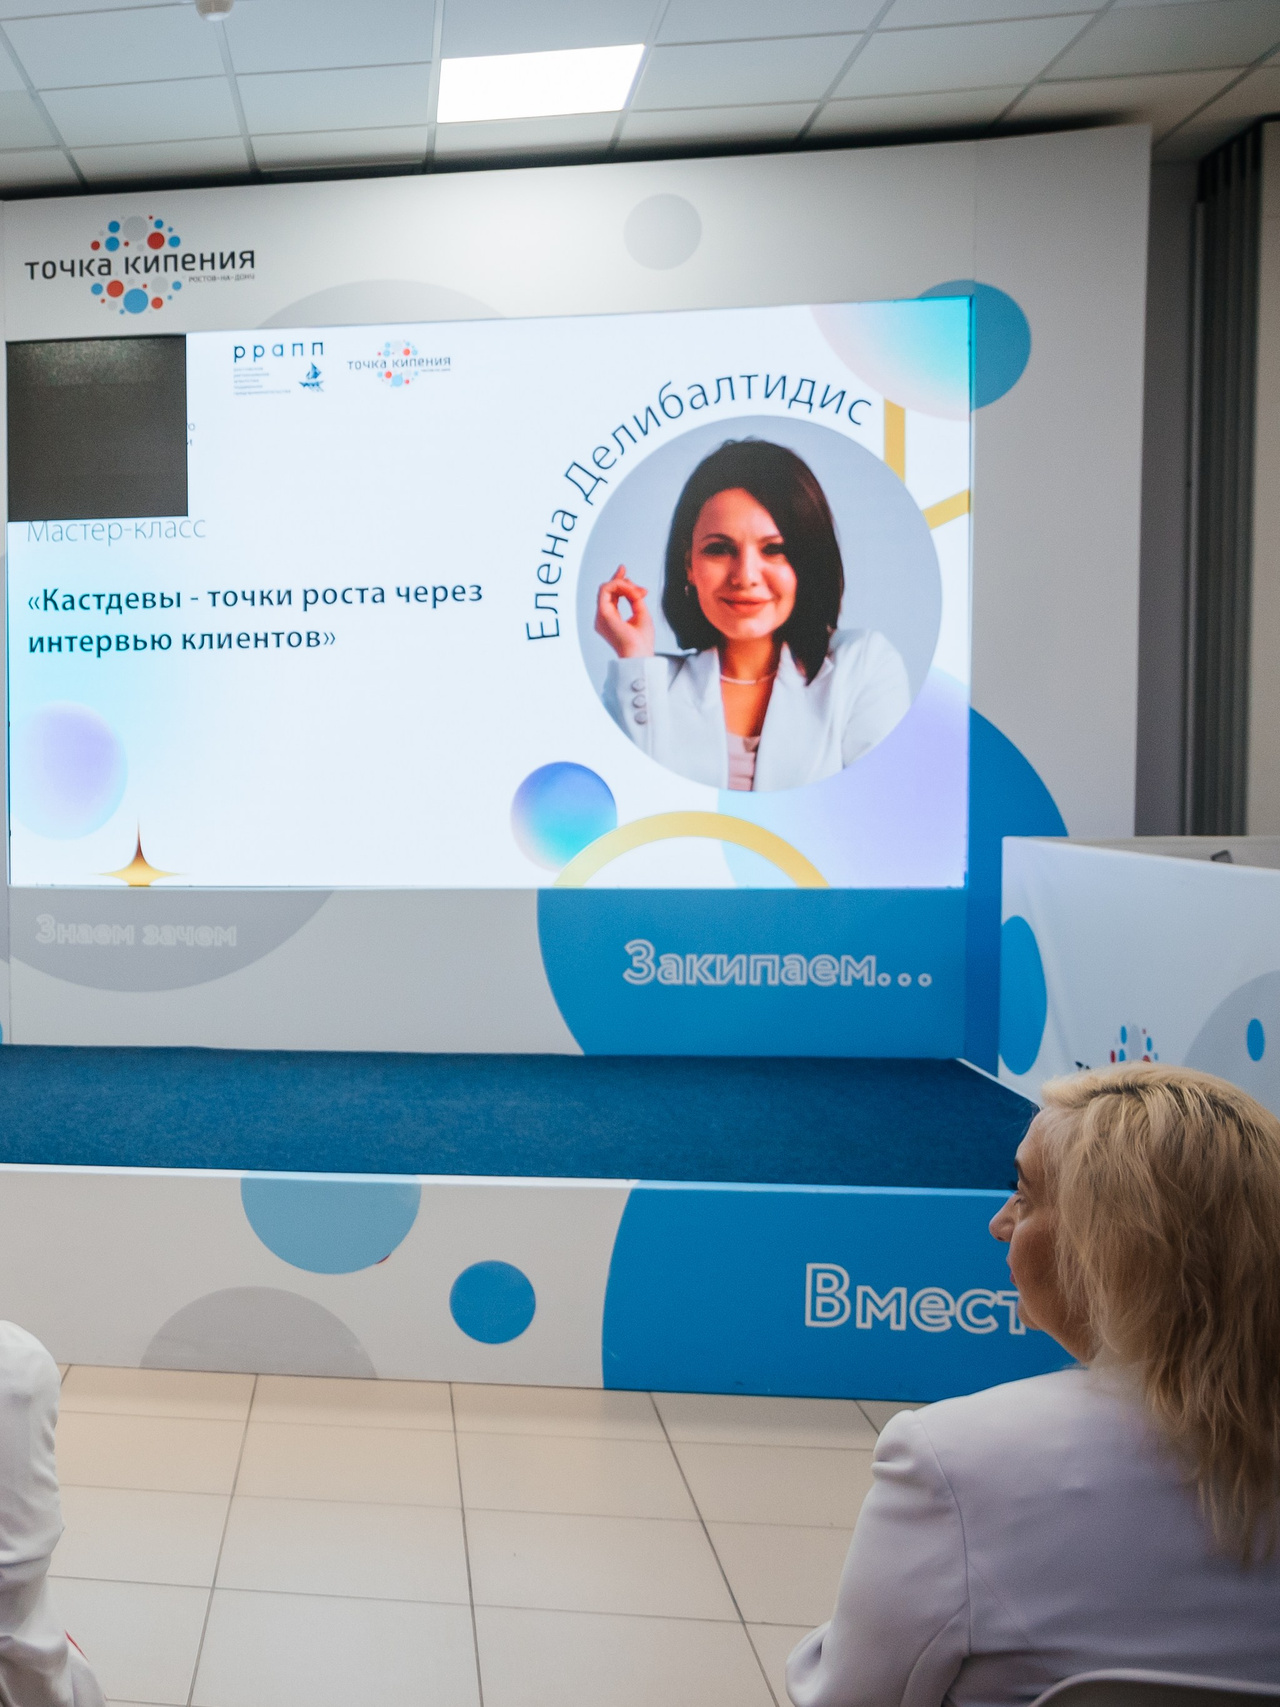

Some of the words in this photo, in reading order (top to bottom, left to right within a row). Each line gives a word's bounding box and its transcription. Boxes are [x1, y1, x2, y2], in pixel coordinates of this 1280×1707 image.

[24, 257, 112, 281] точка
[124, 249, 255, 276] кипения
[347, 359, 387, 371] точка
[391, 356, 452, 369] кипения
[525, 508, 579, 641] Елена
[563, 373, 873, 506] Делибалтидис
[27, 518, 208, 547] Мастер-класс
[28, 588, 182, 616] «Кастдевы
[207, 588, 293, 608] точки
[303, 586, 386, 613] роста
[395, 584, 484, 610] через
[28, 632, 173, 659] интервью
[182, 630, 337, 651] клиентов»
[35, 913, 136, 945] Знаем
[142, 924, 238, 948] зачем
[622, 938, 933, 988] Закипаем...
[804, 1262, 1027, 1336] Вмест
